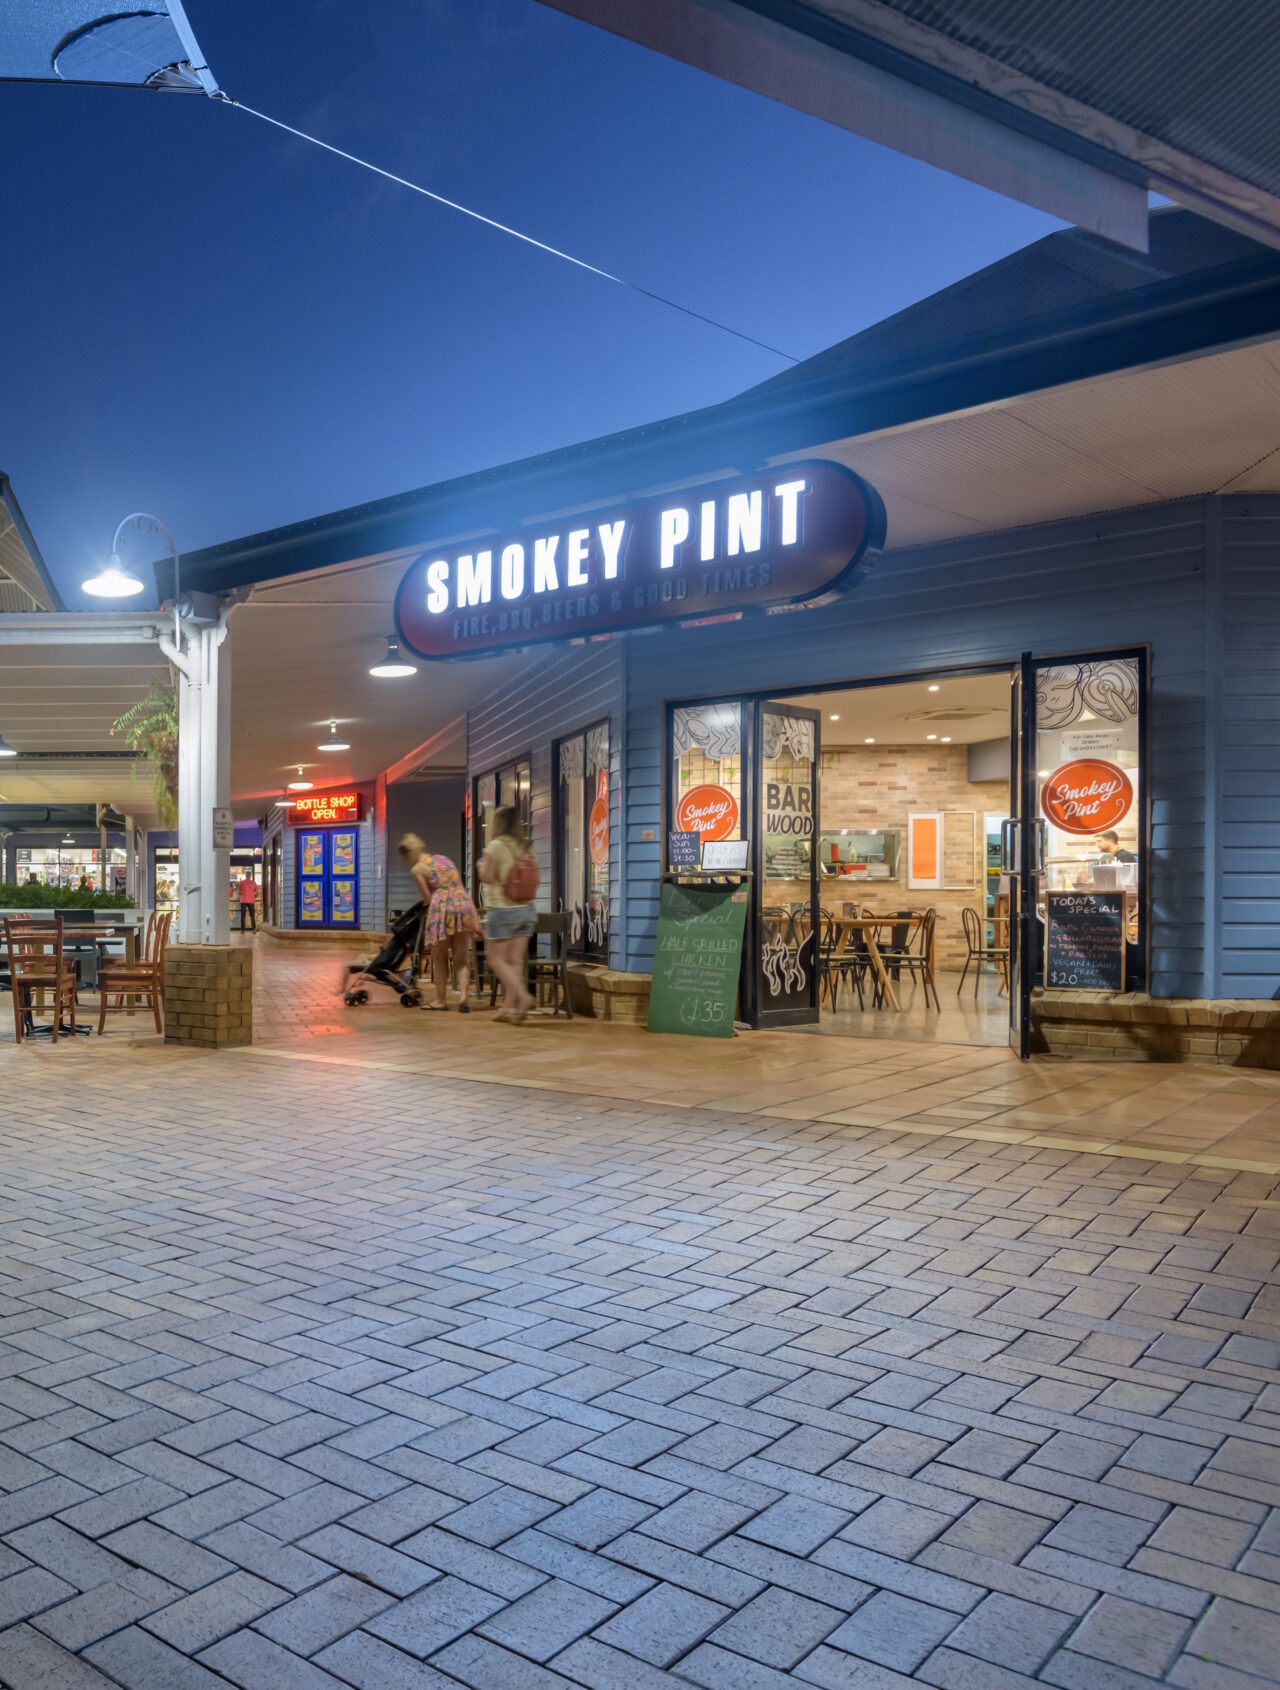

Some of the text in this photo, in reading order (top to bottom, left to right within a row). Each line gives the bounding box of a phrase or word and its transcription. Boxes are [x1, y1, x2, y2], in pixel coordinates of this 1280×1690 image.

[426, 479, 807, 614] SMOKEY PINT
[634, 578, 688, 608] GOOD
[702, 563, 771, 595] TIMES
[767, 783, 811, 813] BAR
[1051, 780, 1118, 804] Smokey
[296, 796, 355, 810] BOTTLE SHOP
[1063, 800, 1101, 820] Pint
[311, 808, 337, 820] OPEN
[683, 801, 729, 822] Smokey
[691, 818, 718, 832] Pint
[767, 813, 813, 835] WOOD
[1051, 895, 1096, 906] TODAY'S
[1068, 904, 1120, 914] SPECIAL
[660, 936, 738, 951] HALF GRILLED
[672, 953, 727, 967] CHICKEN
[1051, 970, 1078, 985] $20
